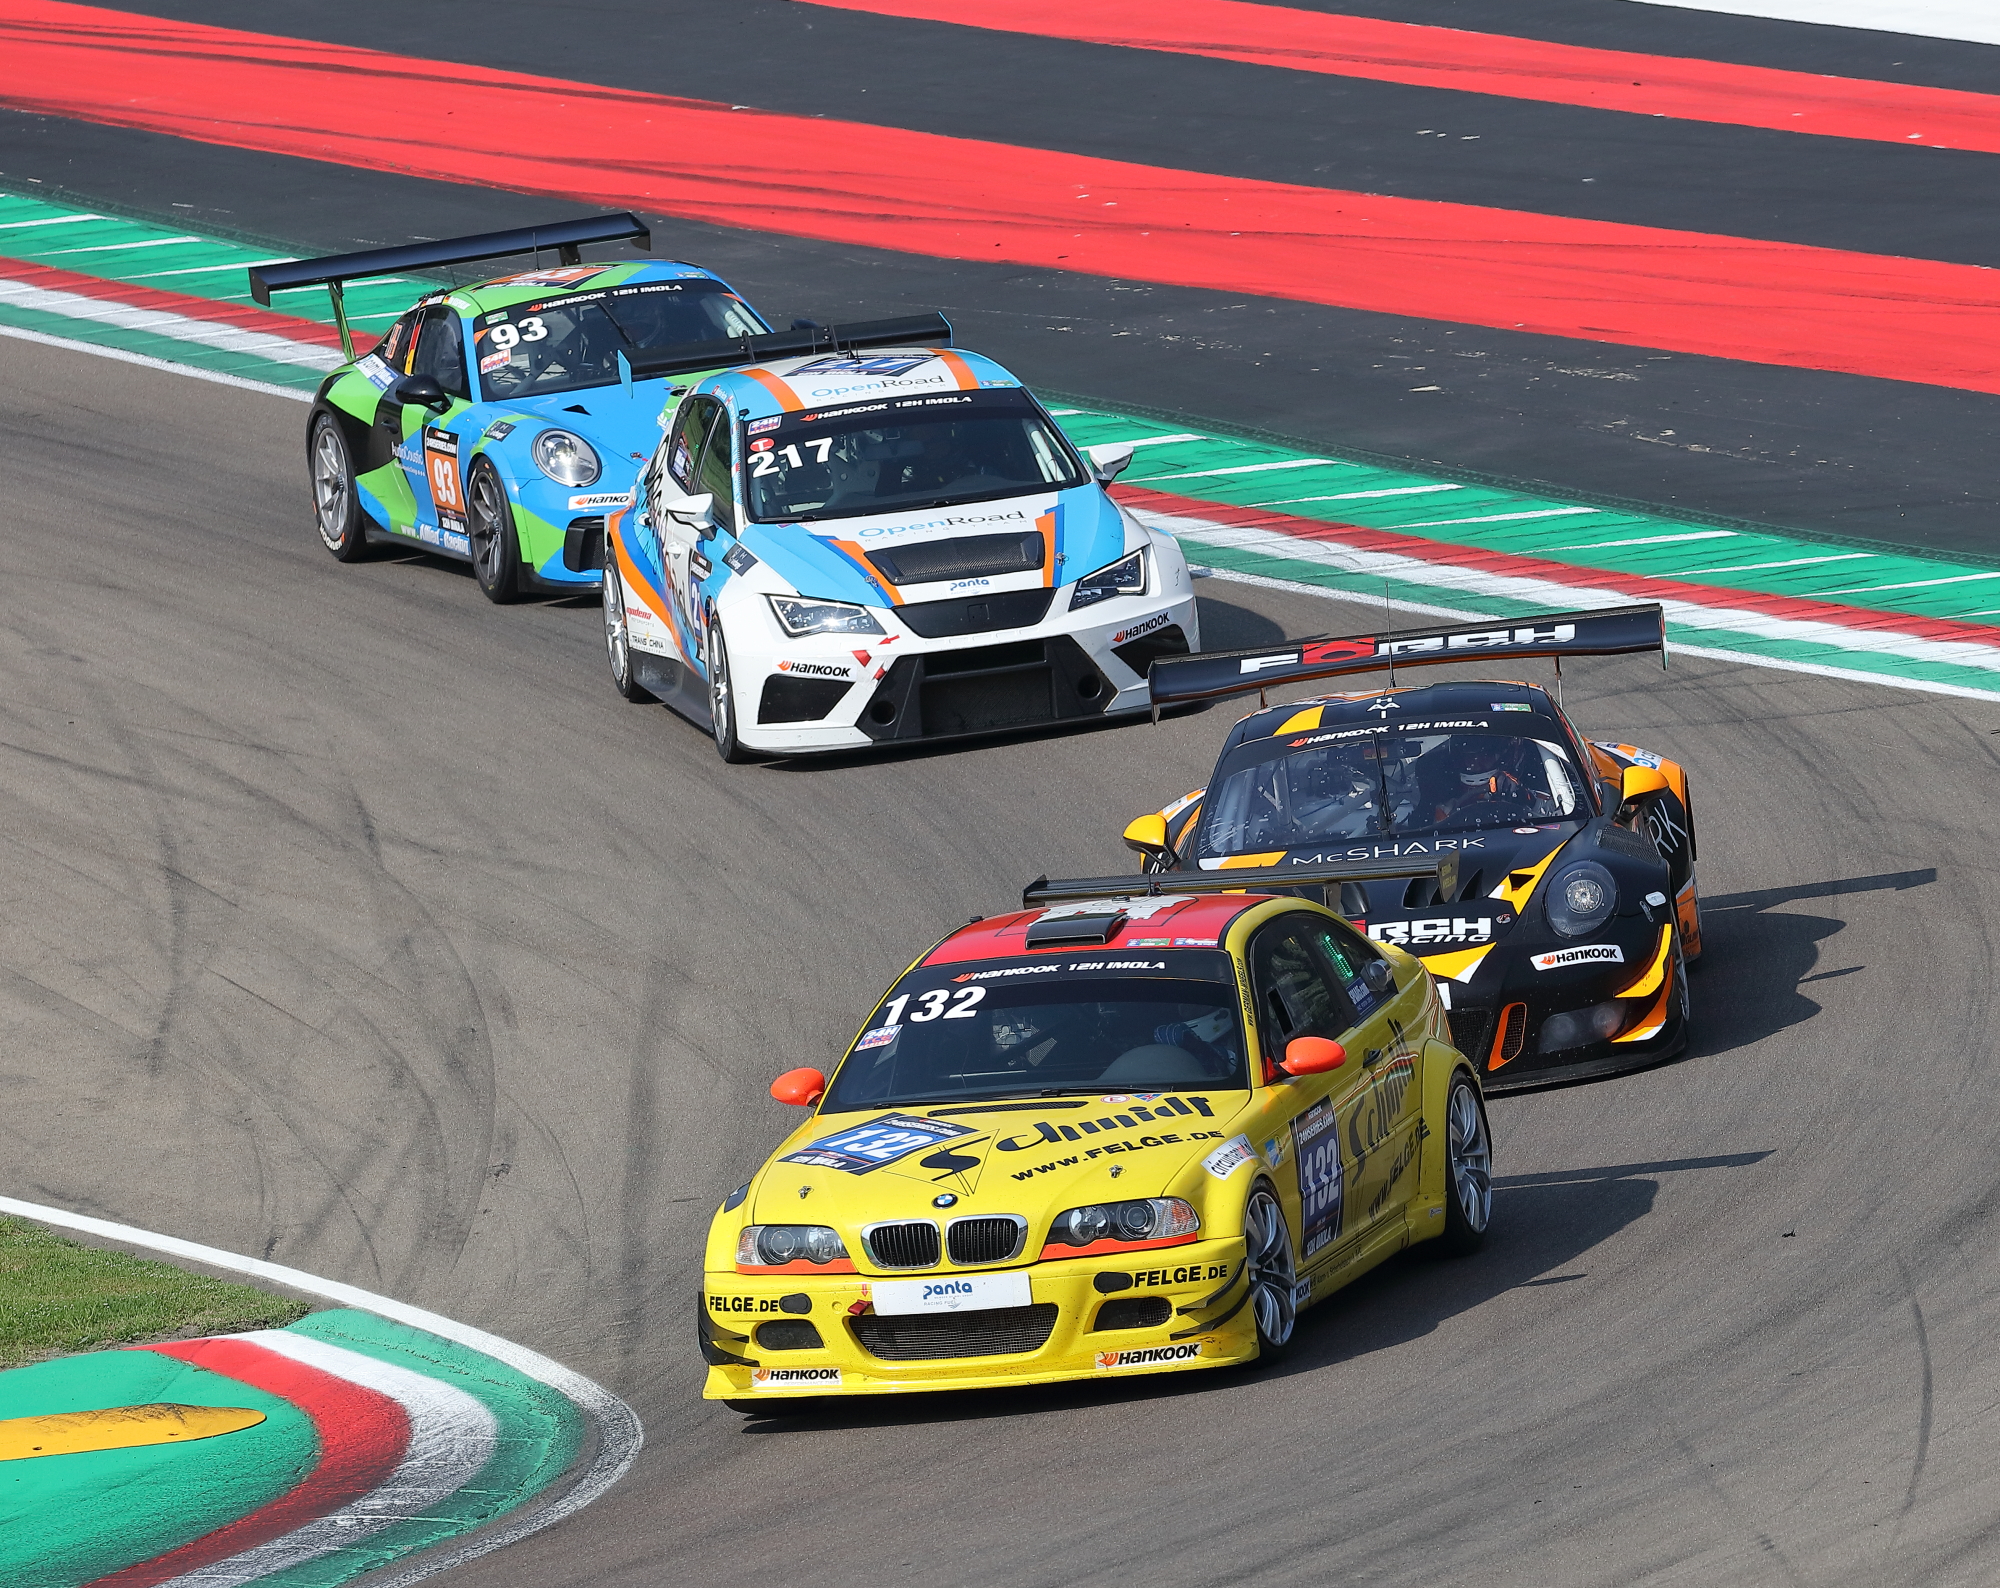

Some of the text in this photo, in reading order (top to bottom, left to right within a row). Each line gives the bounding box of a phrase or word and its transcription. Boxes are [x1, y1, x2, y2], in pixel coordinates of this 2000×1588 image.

[611, 288, 638, 297] 12H
[640, 284, 683, 293] IMOLA
[490, 316, 548, 350] 93
[811, 375, 946, 397] OpenRoad
[894, 399, 923, 409] 12H
[925, 396, 973, 406] IMOLA
[747, 437, 833, 478] 217
[433, 458, 457, 506] 93
[588, 494, 629, 505] HanKO
[858, 510, 1027, 538] OpenRoad
[950, 578, 990, 592] panta
[631, 633, 648, 646] TRANS
[649, 636, 664, 649] CHINA
[1398, 722, 1431, 731] 12H
[1433, 720, 1489, 729] IMOLA
[1292, 837, 1485, 866] McSHARK
[1067, 962, 1105, 971] 12H
[1106, 961, 1166, 970] IMOLA
[883, 986, 987, 1026] 132
[864, 1025, 900, 1040] 24H
[823, 1128, 934, 1159] 132
[1010, 1130, 1226, 1182] www.FELGE.DE
[1304, 1138, 1340, 1217] 132
[1134, 1265, 1228, 1288] FELGE.DE
[923, 1280, 973, 1300] panta
[709, 1296, 779, 1312] FELGE.DE
